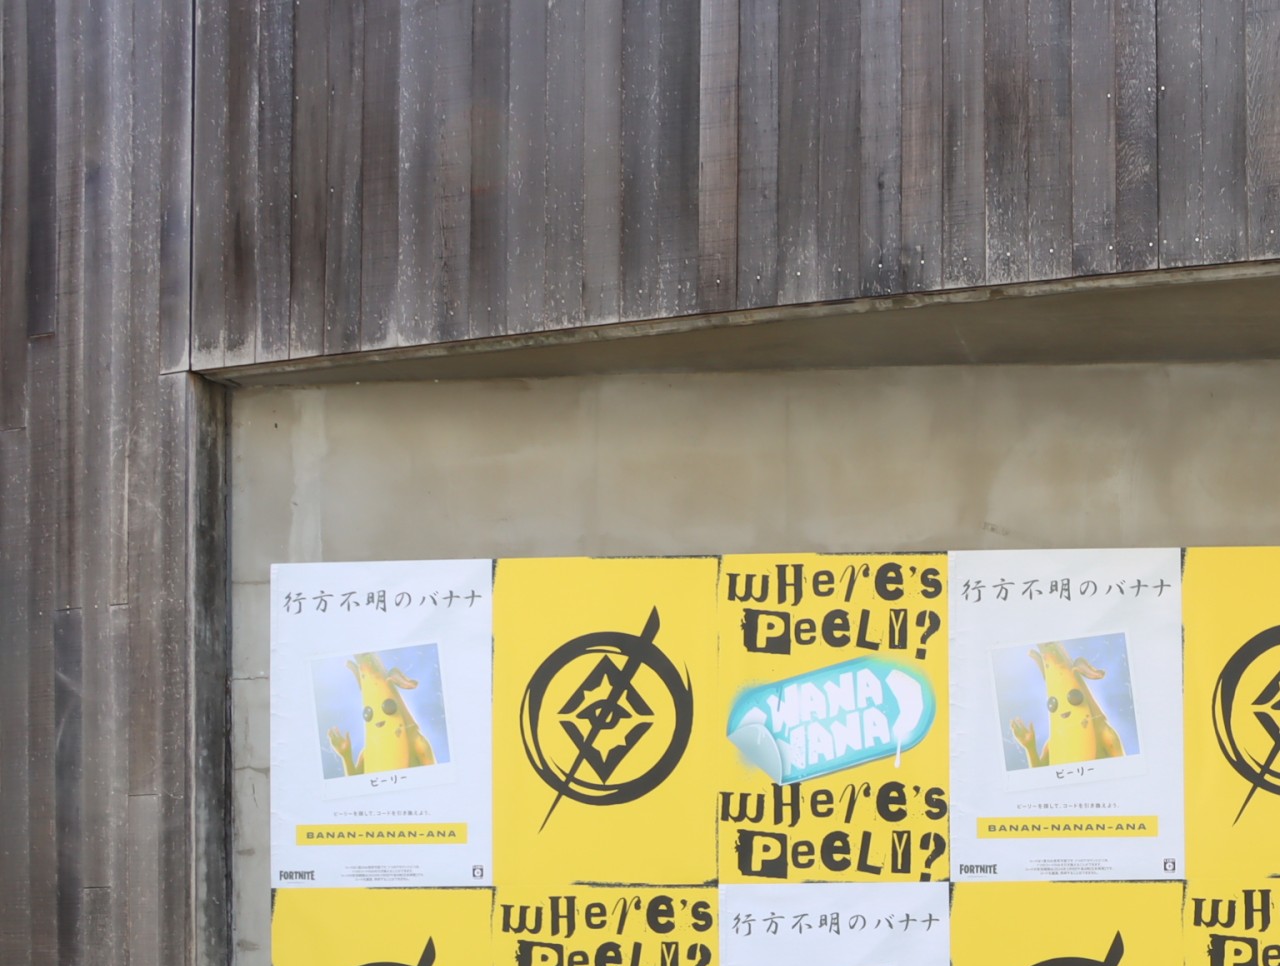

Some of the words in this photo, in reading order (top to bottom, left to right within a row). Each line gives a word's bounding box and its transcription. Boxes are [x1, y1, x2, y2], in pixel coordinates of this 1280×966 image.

[961, 578, 1172, 603] 行方不明のバナナ
[283, 590, 483, 614] 行方不明のバナナ
[988, 823, 1147, 832] BANAN-NANAN-ANA
[306, 830, 457, 839] BANAN-NANAN-ANA
[278, 869, 315, 881] FORTNITE
[959, 863, 998, 875] FORTNITE
[732, 912, 940, 937] 行方不明のバナナ
